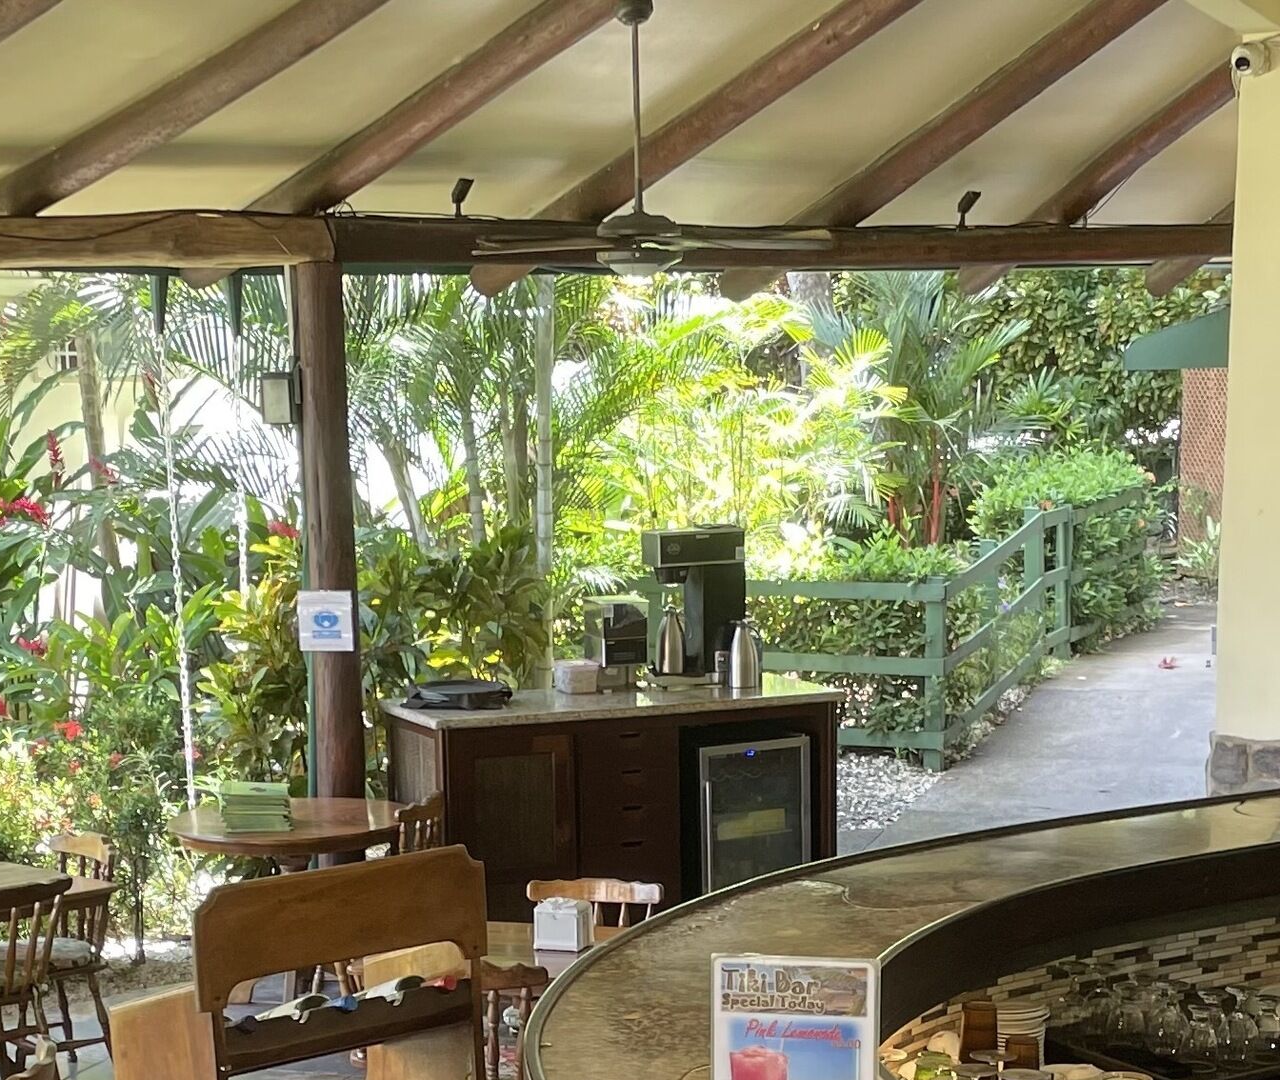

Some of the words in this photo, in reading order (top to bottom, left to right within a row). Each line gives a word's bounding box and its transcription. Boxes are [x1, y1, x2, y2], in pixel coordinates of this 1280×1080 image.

[721, 964, 767, 994] Tiki
[775, 969, 821, 996] Bar
[721, 993, 775, 1011] Special
[778, 995, 826, 1015] Today
[744, 1018, 778, 1039] Pink
